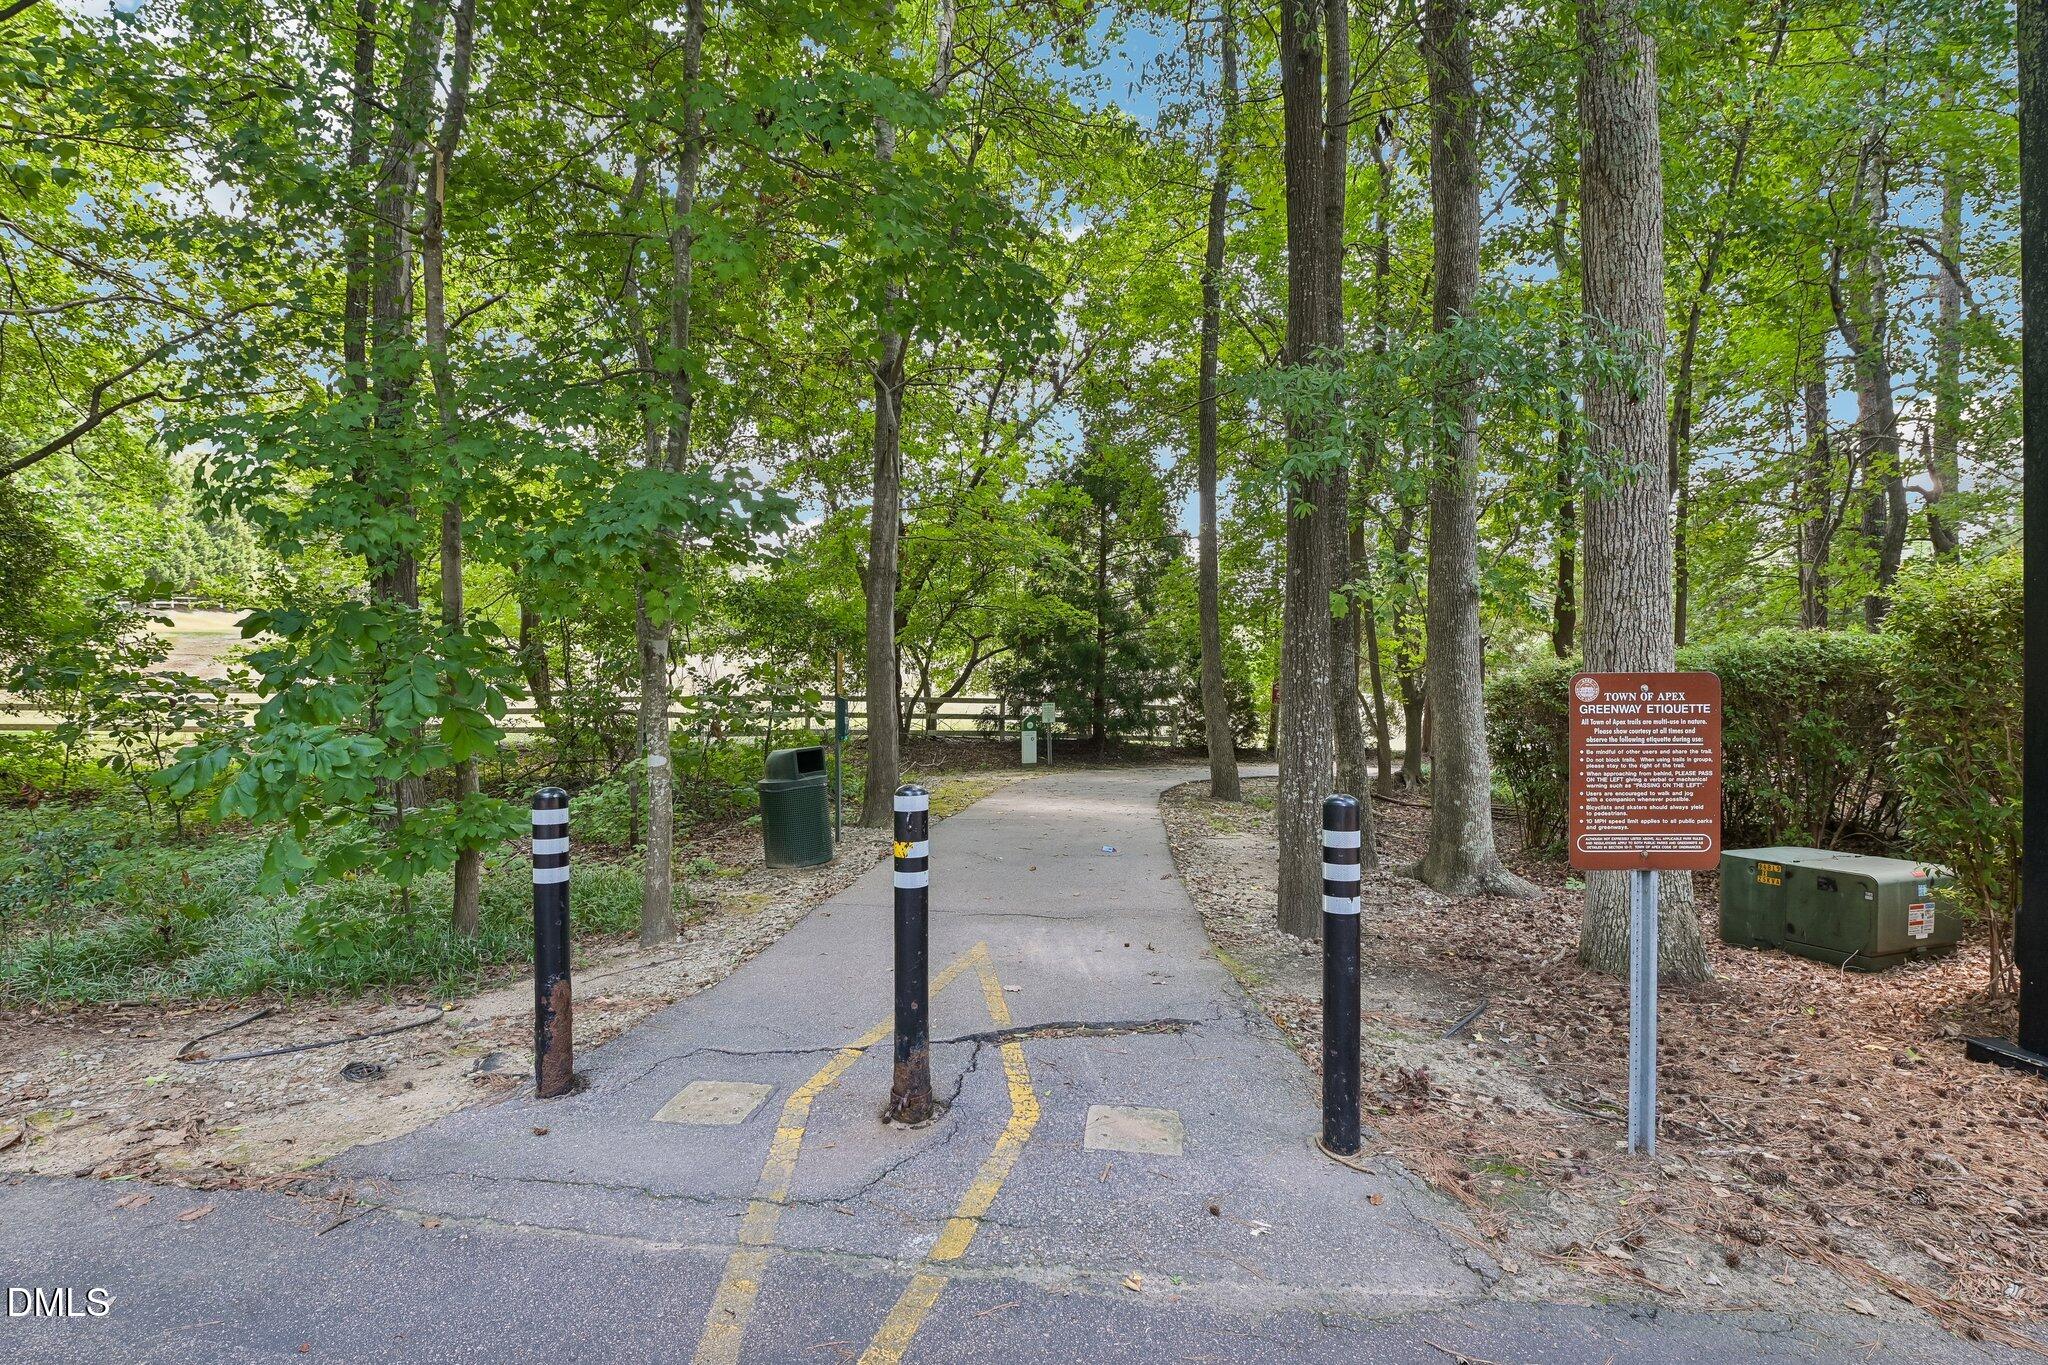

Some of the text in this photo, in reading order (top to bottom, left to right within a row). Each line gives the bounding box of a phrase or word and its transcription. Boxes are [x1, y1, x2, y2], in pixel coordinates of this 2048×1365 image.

[1604, 692, 1637, 702] TOWN
[1640, 692, 1654, 702] OF
[1657, 692, 1685, 702] APEX
[1579, 704, 1710, 713] GREENWAY ETIQUETTE
[1605, 718, 1611, 726] of
[1612, 718, 1626, 726] Apex
[1629, 727, 1651, 735] courtesy
